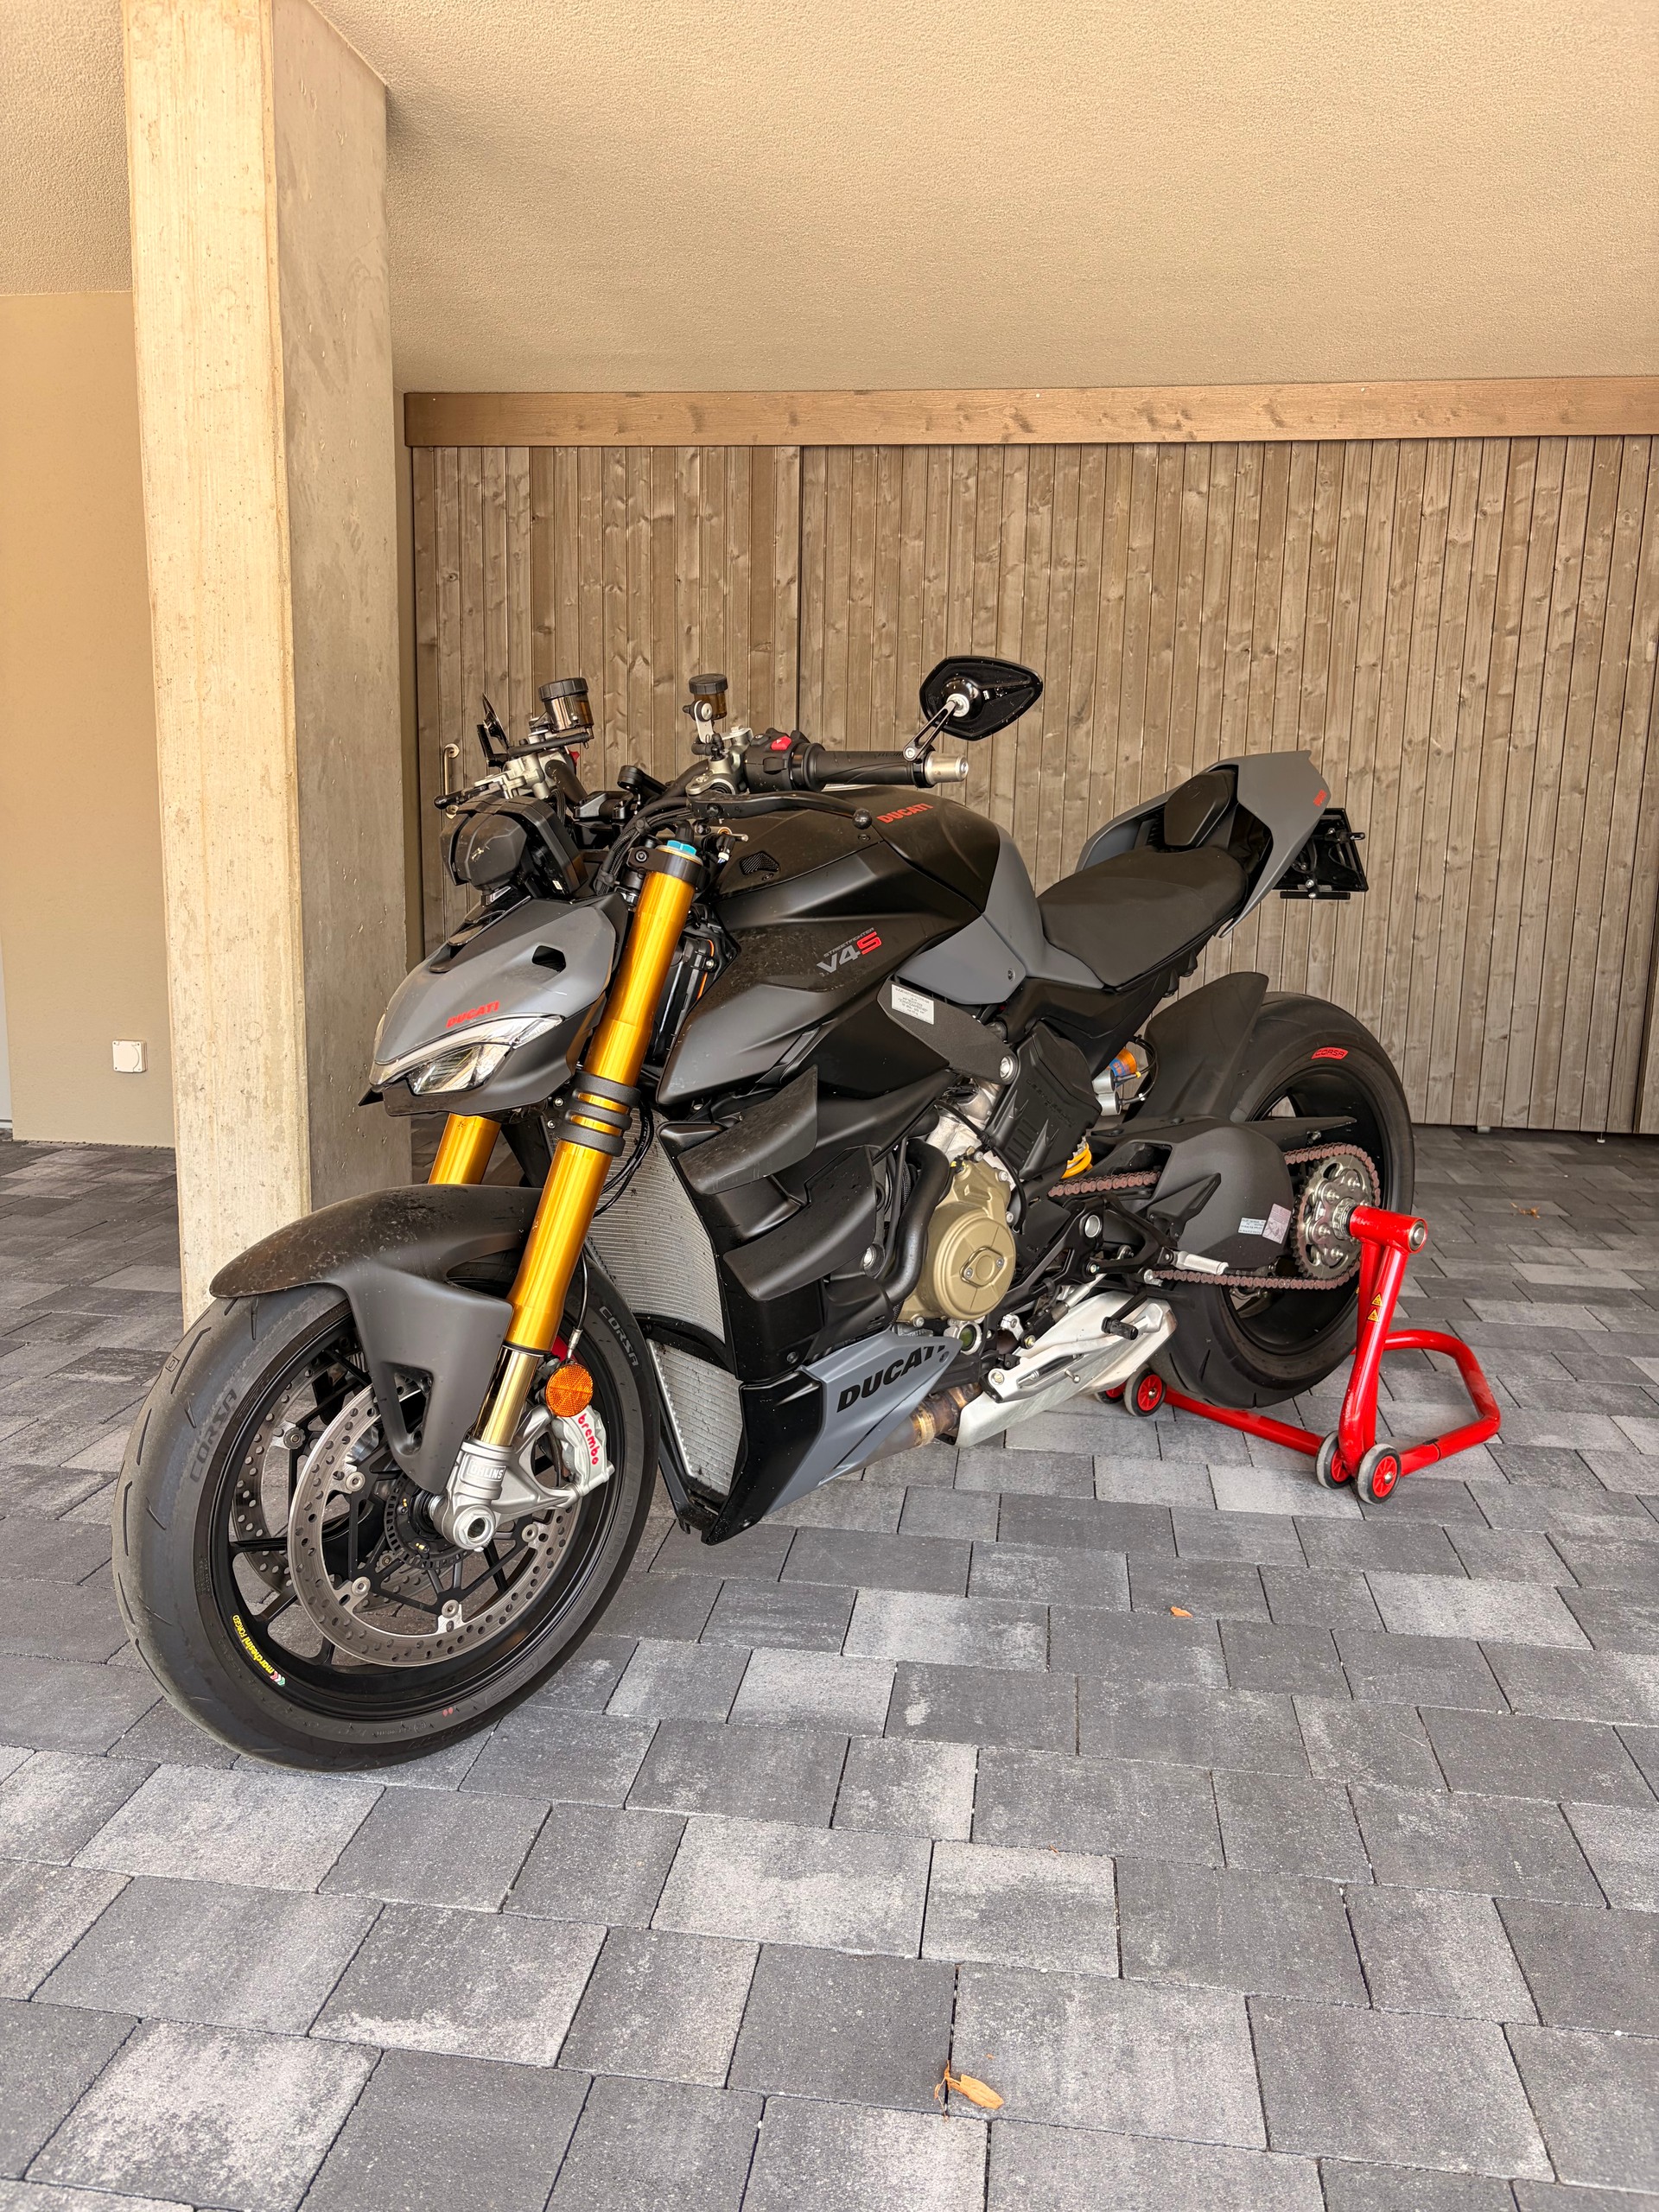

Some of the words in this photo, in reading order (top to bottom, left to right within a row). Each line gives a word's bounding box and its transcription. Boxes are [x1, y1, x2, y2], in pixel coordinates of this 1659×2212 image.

[876, 803, 933, 823] DUCATI
[816, 931, 882, 974] V4S
[446, 1001, 499, 1028] DUCATI
[599, 1306, 639, 1366] CORSA
[190, 1389, 238, 1483] CORSA
[577, 1413, 600, 1465] brembo
[232, 1614, 247, 1638] FORGED
[242, 1637, 275, 1674] marchesini
